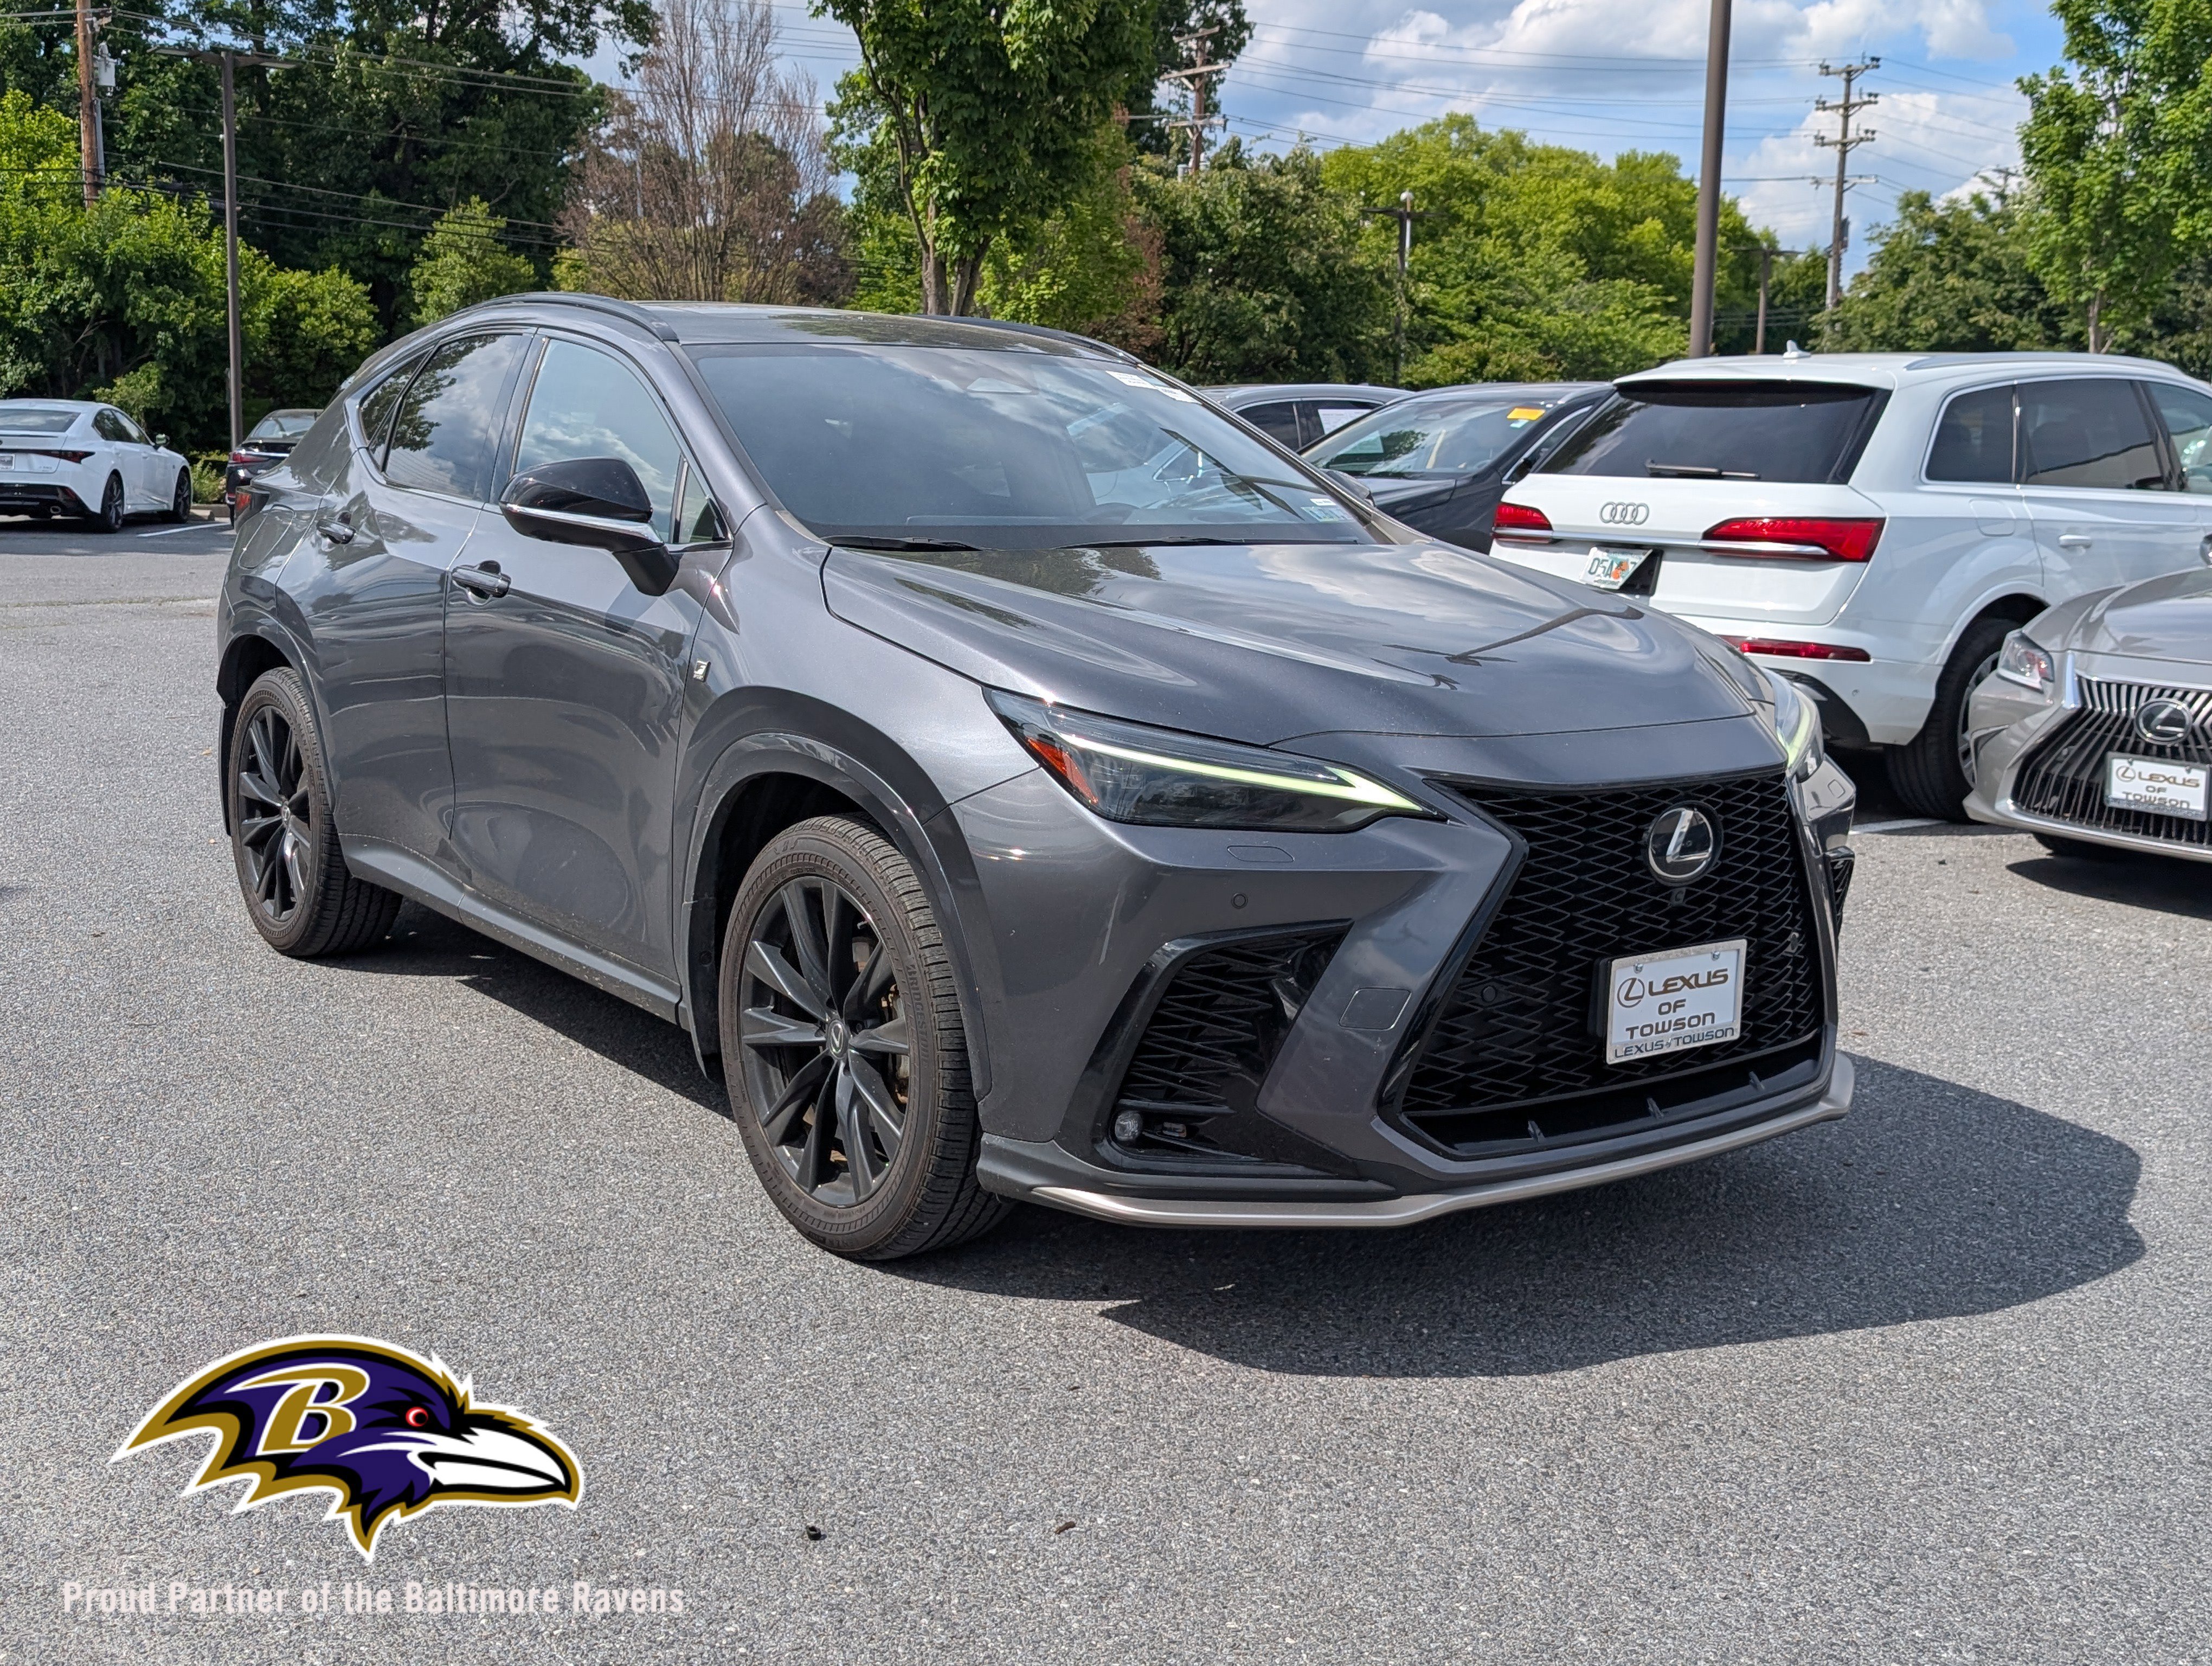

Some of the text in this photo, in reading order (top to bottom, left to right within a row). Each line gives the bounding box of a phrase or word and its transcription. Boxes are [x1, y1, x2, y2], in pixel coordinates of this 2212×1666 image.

[2138, 771, 2200, 788] LEXUS
[2145, 785, 2167, 793] OF
[2122, 791, 2190, 809] TOWSON
[1648, 968, 1729, 997] LEXUS
[1658, 998, 1687, 1016] OF
[1625, 1011, 1715, 1040] TOWSON
[1614, 1039, 1664, 1058] LEXUS
[1673, 1027, 1735, 1047] TOWSON
